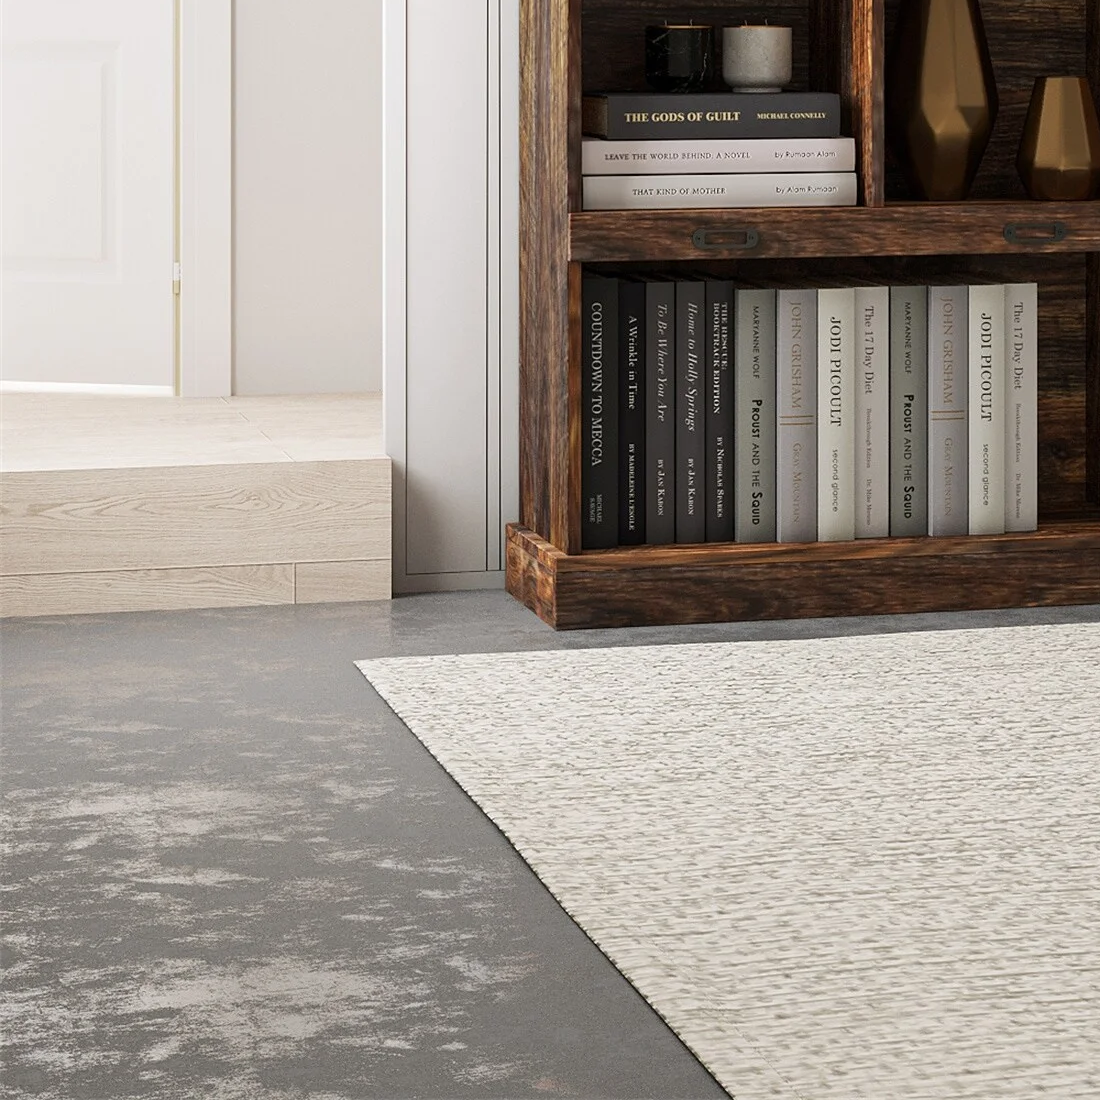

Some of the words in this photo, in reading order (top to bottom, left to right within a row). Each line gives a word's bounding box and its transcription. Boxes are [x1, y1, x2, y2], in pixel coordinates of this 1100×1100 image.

[624, 113, 648, 123] THE
[652, 112, 684, 122] GODS
[687, 112, 703, 122] OF
[706, 111, 740, 122] GUILT
[628, 316, 637, 324] A
[657, 304, 667, 317] To
[688, 303, 698, 335] Home
[789, 301, 801, 338] JOHN
[864, 306, 874, 327] The
[1014, 302, 1023, 323] The
[657, 321, 667, 334] Be
[752, 306, 760, 353] MARYANNE
[830, 317, 841, 353] JODI
[864, 331, 874, 343] 17
[904, 302, 912, 349] MARYANNE
[981, 313, 992, 348] JODI
[1014, 327, 1023, 338] 17
[591, 302, 602, 392] COUNTDOWN
[628, 327, 637, 367] Wrinkle
[688, 339, 698, 349] to
[1012, 342, 1023, 363] Day
[657, 339, 667, 374] Where
[685, 353, 698, 382] Holly
[752, 356, 760, 379] WOLF
[863, 347, 874, 368] Day
[904, 351, 912, 374] WOLF
[628, 371, 637, 380] in
[792, 344, 801, 409] GRISHAM
[864, 372, 874, 394] Diet
[1014, 367, 1023, 389] Diet
[628, 384, 637, 409] Time
[657, 378, 667, 397] You
[830, 360, 841, 426] PICOULT
[981, 355, 992, 421] PICOULT
[591, 396, 602, 413] TO
[657, 401, 667, 421] Are
[685, 387, 697, 431] Springs
[591, 418, 602, 465] MECCA
[832, 450, 840, 480] second
[832, 483, 840, 512] glance
